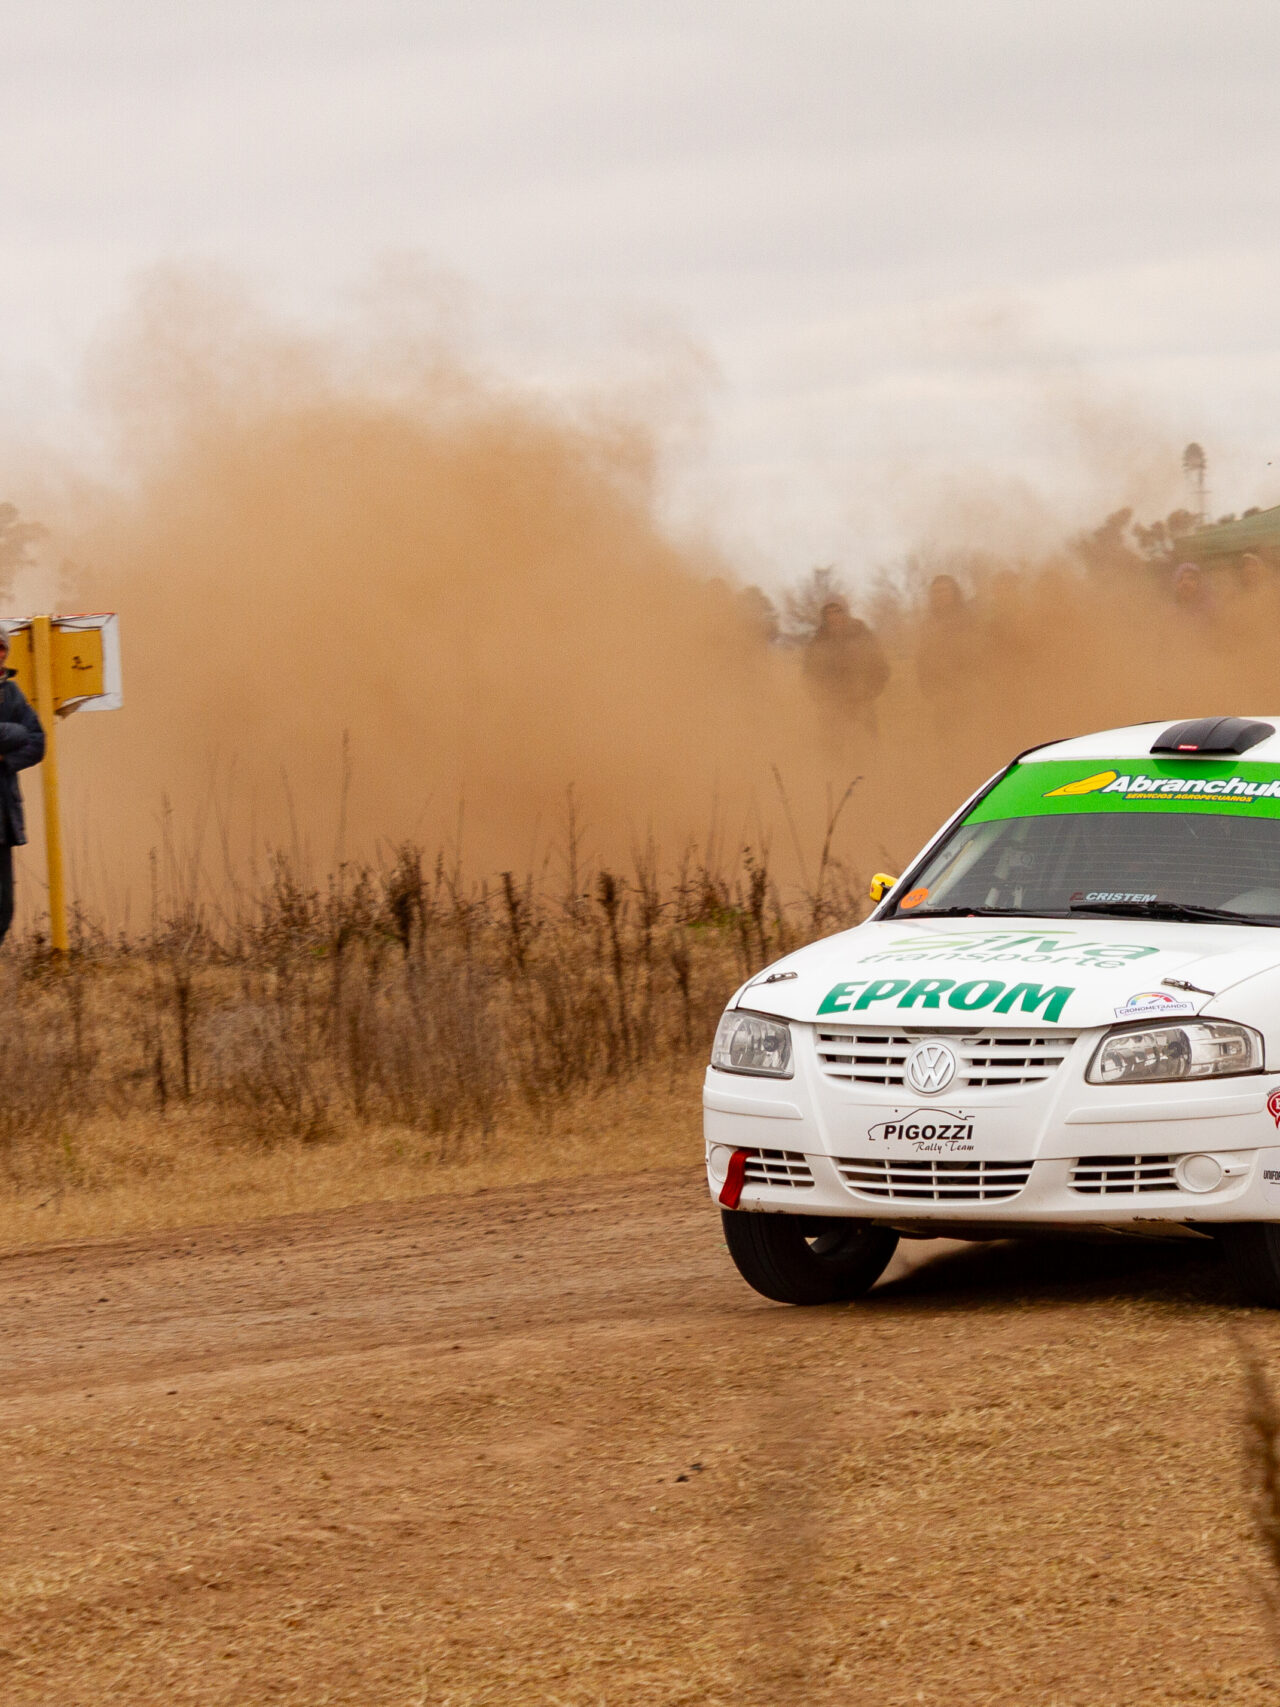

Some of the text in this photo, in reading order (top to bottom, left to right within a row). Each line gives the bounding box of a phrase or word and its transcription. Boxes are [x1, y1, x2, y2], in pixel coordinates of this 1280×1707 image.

[1125, 792, 1253, 802] SERVICIOS AGROPECUARIOS
[1085, 892, 1158, 902] CRISTEM
[877, 930, 1160, 960] Silva
[857, 951, 1126, 968] transporte
[816, 978, 1076, 1023] EPROM
[883, 1124, 974, 1140] PIGOZZI
[912, 1140, 974, 1154] Rally Team
